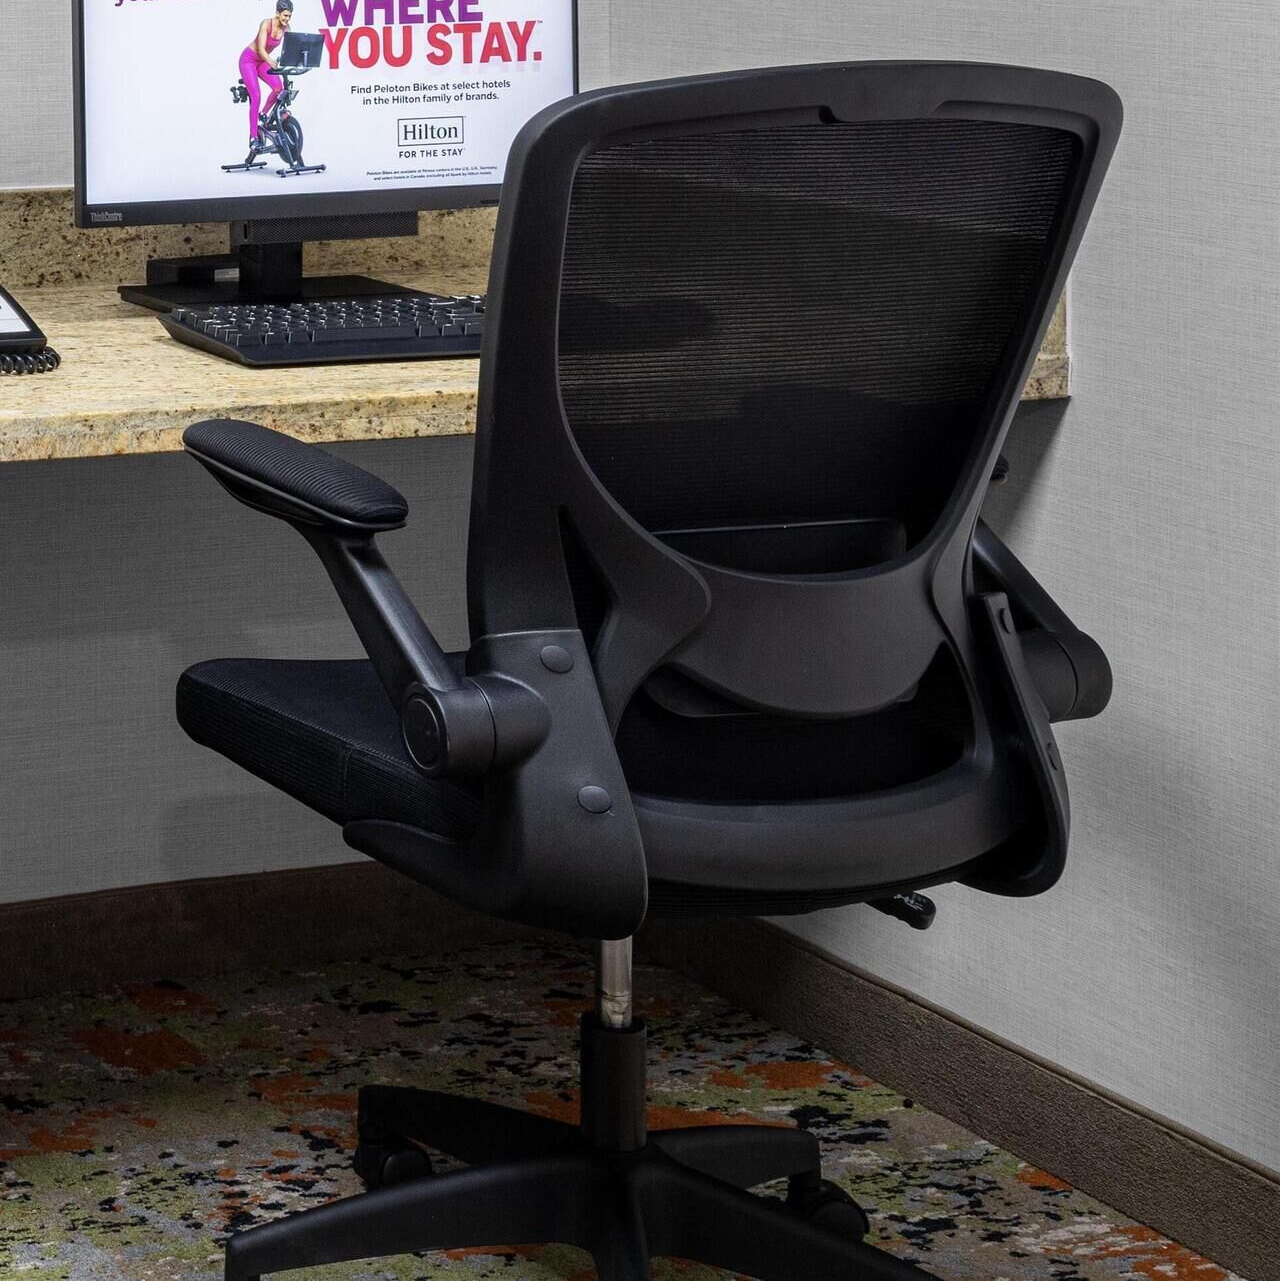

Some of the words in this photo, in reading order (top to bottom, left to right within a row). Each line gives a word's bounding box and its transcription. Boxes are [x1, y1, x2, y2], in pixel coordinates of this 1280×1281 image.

[319, 25, 413, 69] YOU
[426, 20, 542, 66] STAY.
[350, 85, 372, 95] Find
[374, 83, 411, 94] Peloton
[413, 82, 438, 92] Bikes
[440, 82, 450, 91] at
[452, 80, 480, 90] select
[482, 79, 511, 89] hotels
[362, 96, 372, 105] in
[374, 95, 390, 105] the
[392, 93, 421, 104] Hilton
[422, 93, 452, 105] family
[453, 92, 464, 102] of
[465, 90, 500, 101] brands.
[403, 123, 458, 141] Hilton
[399, 150, 417, 159] FOR
[420, 149, 438, 158] THE
